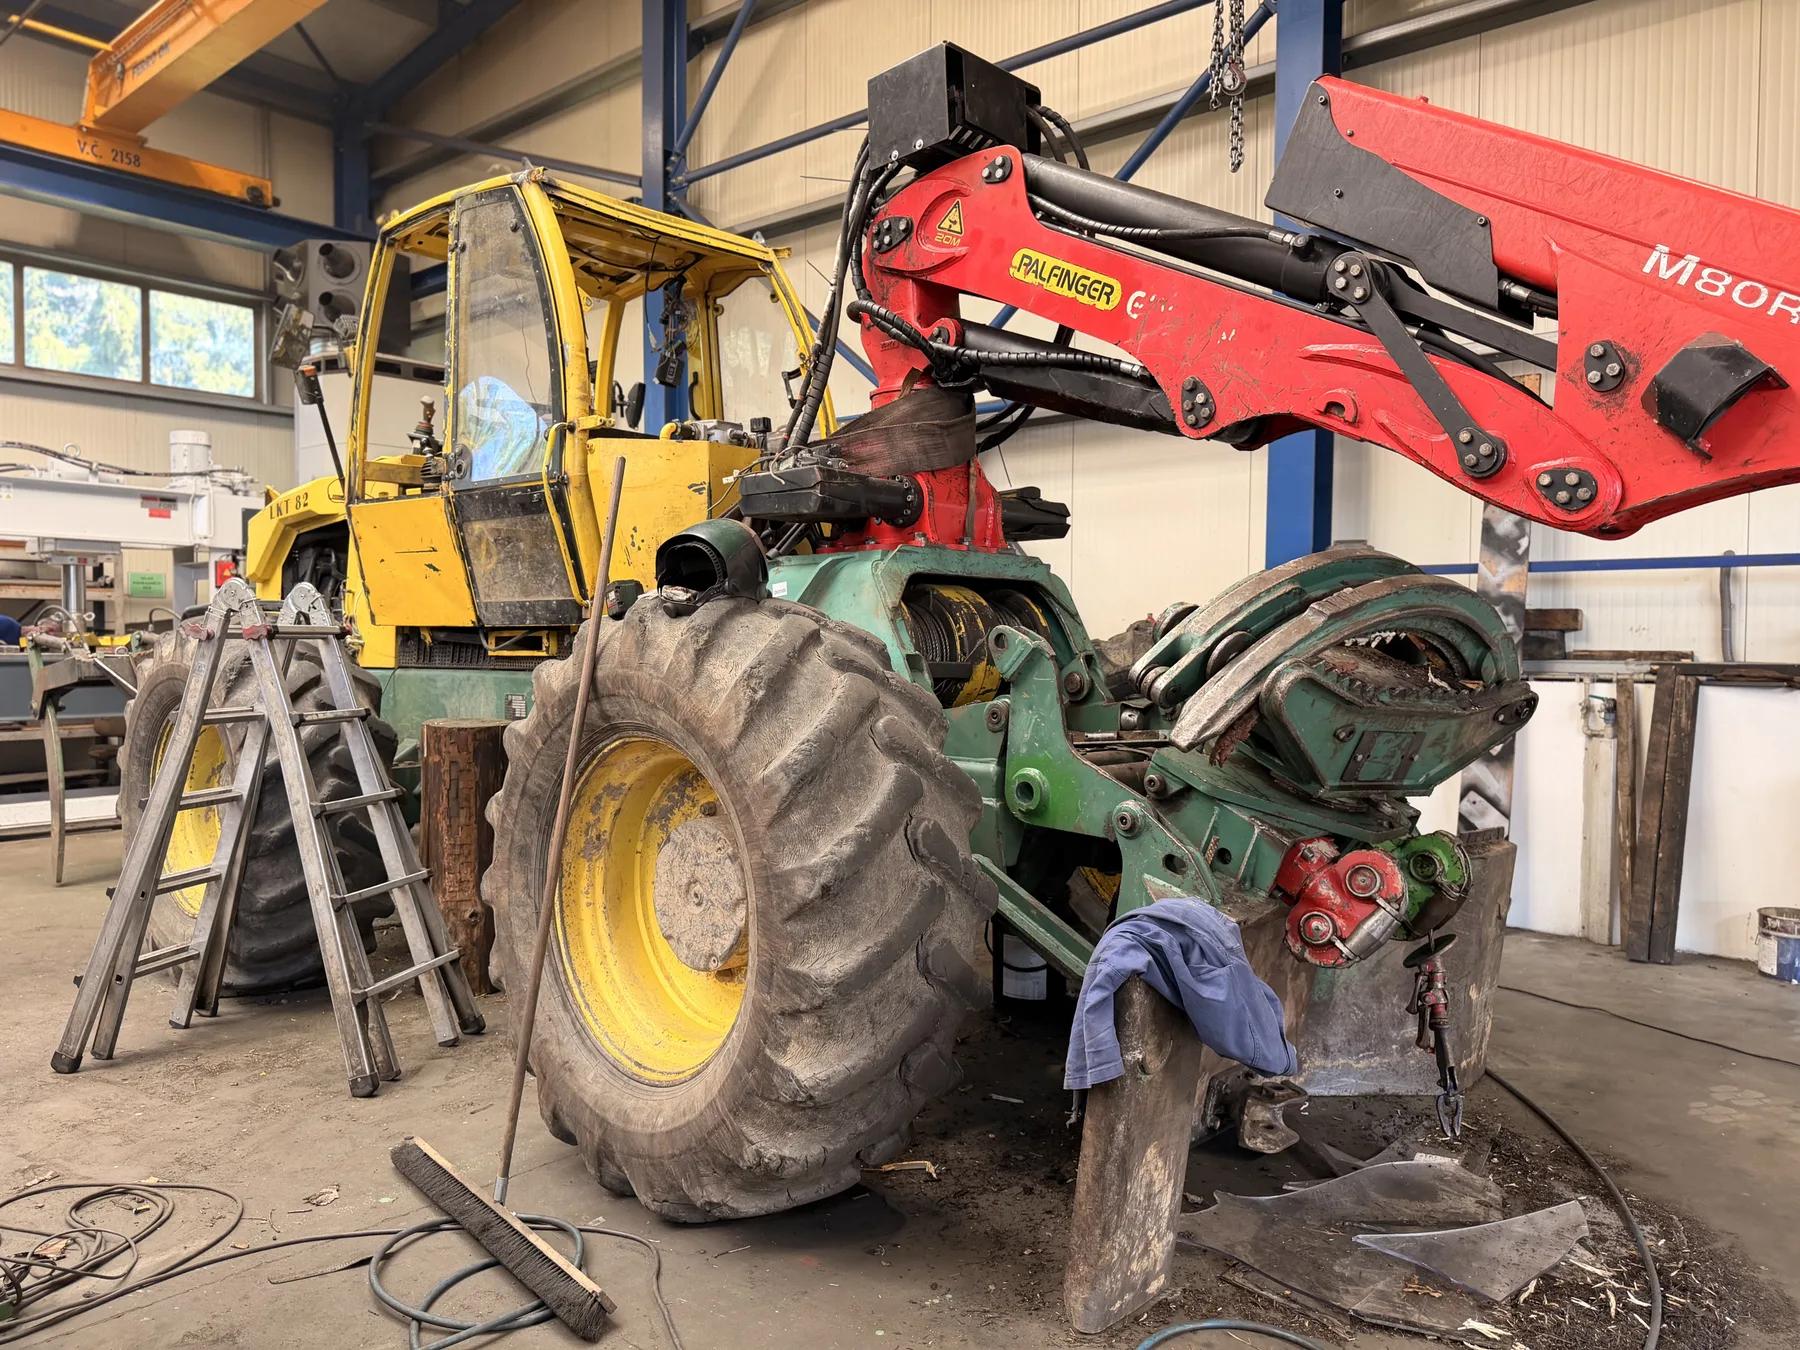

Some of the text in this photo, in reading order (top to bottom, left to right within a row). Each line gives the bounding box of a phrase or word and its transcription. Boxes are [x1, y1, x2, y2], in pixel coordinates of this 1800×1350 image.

[111, 148, 141, 168] 2158
[1016, 253, 1115, 305] PALFINGER
[269, 491, 309, 520] LKT 82
